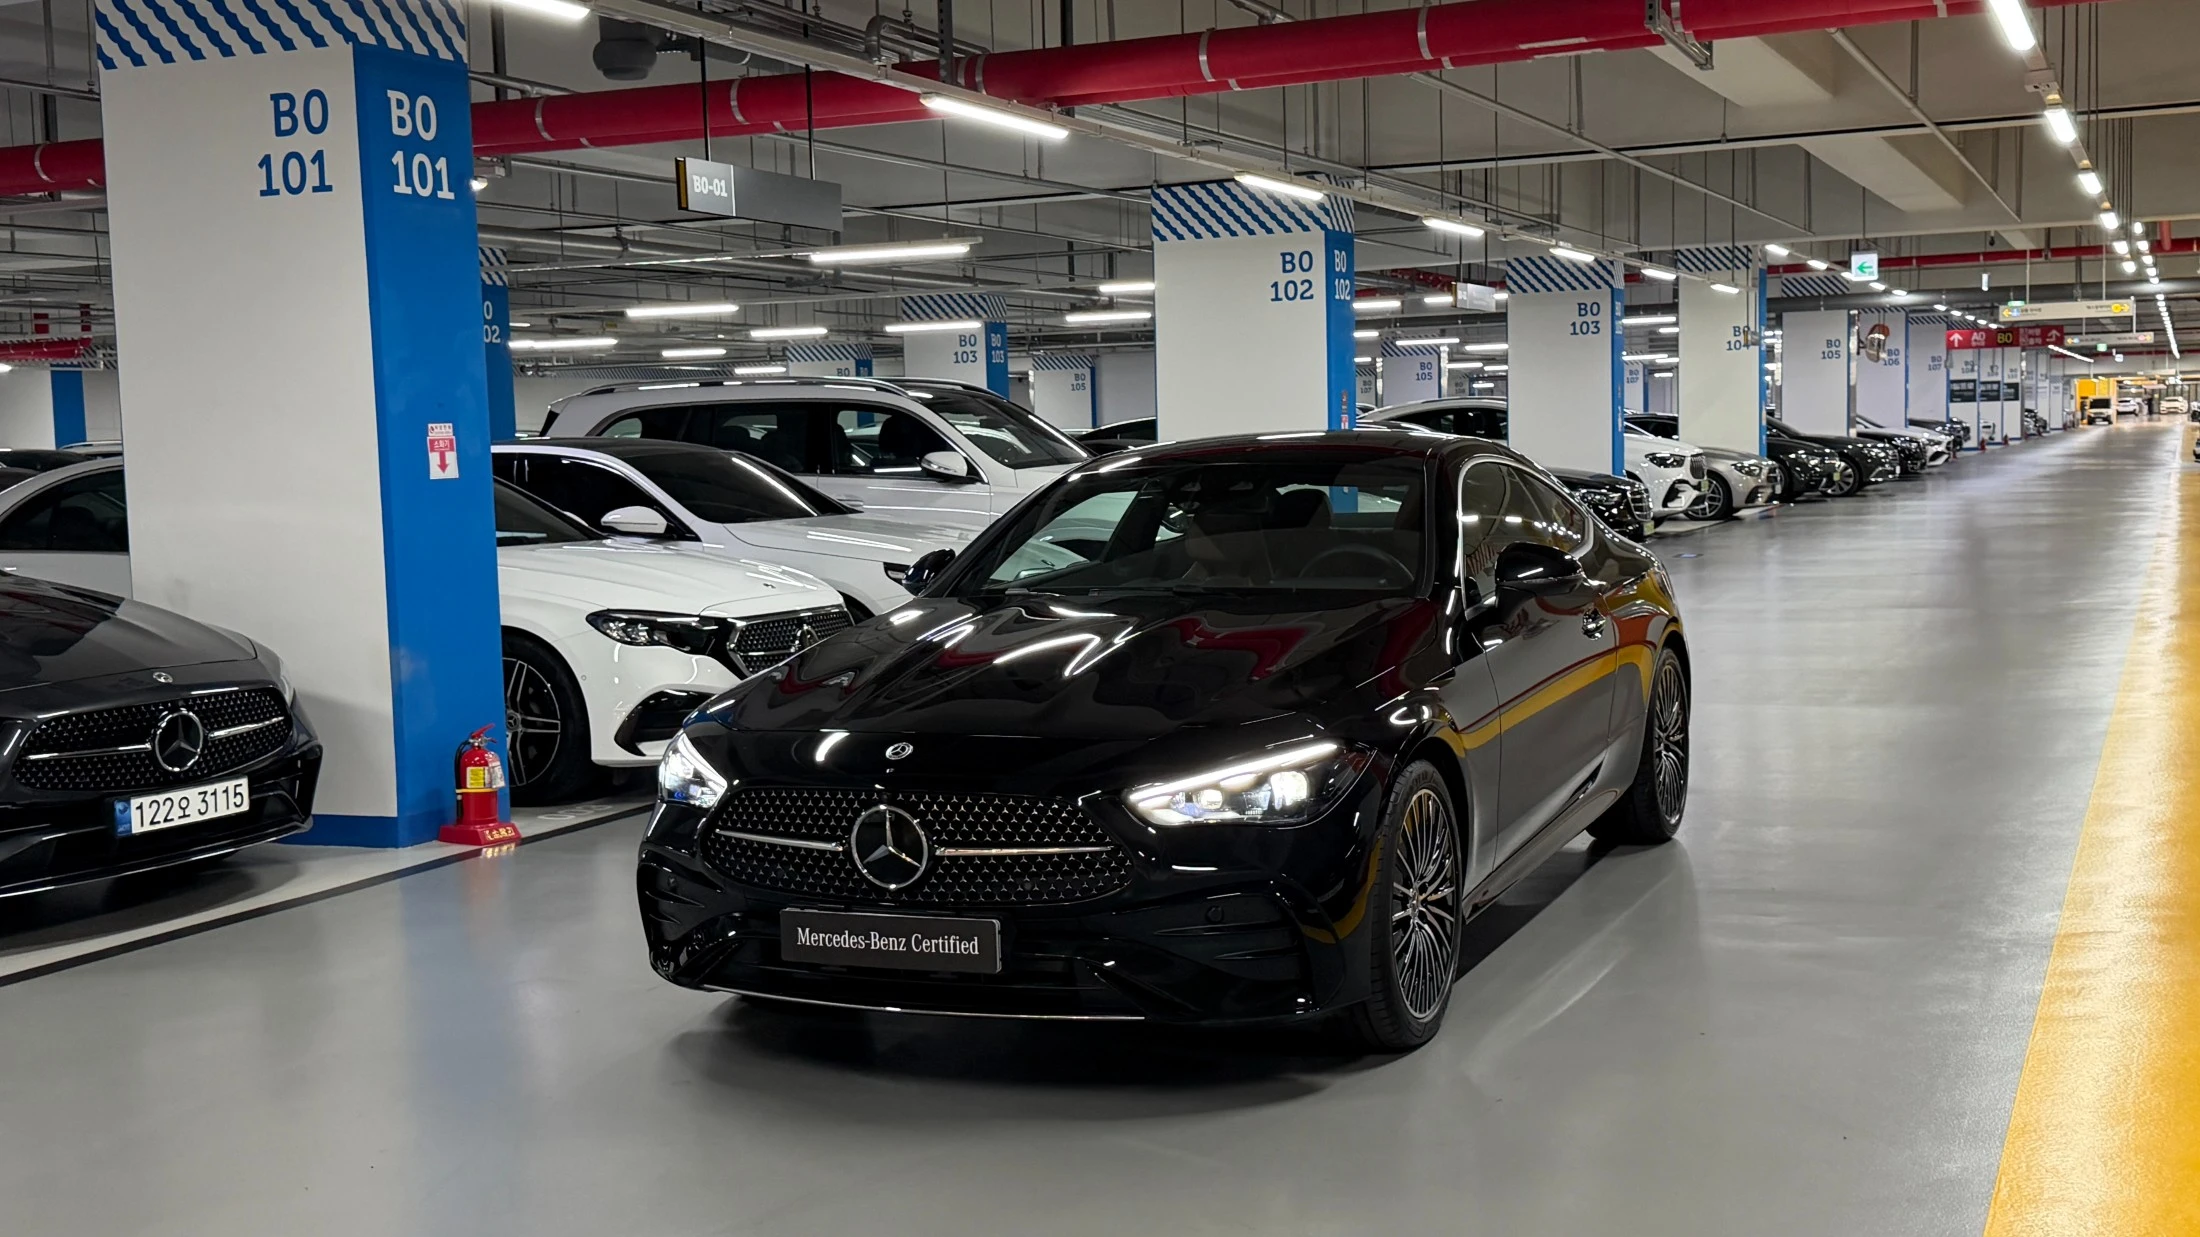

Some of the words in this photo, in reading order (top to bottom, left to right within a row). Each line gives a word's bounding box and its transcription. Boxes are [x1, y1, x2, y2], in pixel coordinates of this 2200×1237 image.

[257, 149, 334, 197] 101
[391, 150, 456, 200] 101
[1270, 278, 1314, 302] 102
[1334, 278, 1351, 301] 102
[484, 324, 501, 343] 02
[1569, 320, 1601, 335] 103
[953, 350, 978, 364] 103
[991, 349, 1005, 364] 103
[1820, 350, 1842, 360] 105
[1415, 372, 1433, 381] 105
[1070, 382, 1087, 391] 105
[135, 796, 191, 828] 122오
[198, 783, 244, 816] 3115
[796, 927, 907, 952] Mercedes-Benz
[911, 933, 980, 955] Certified
